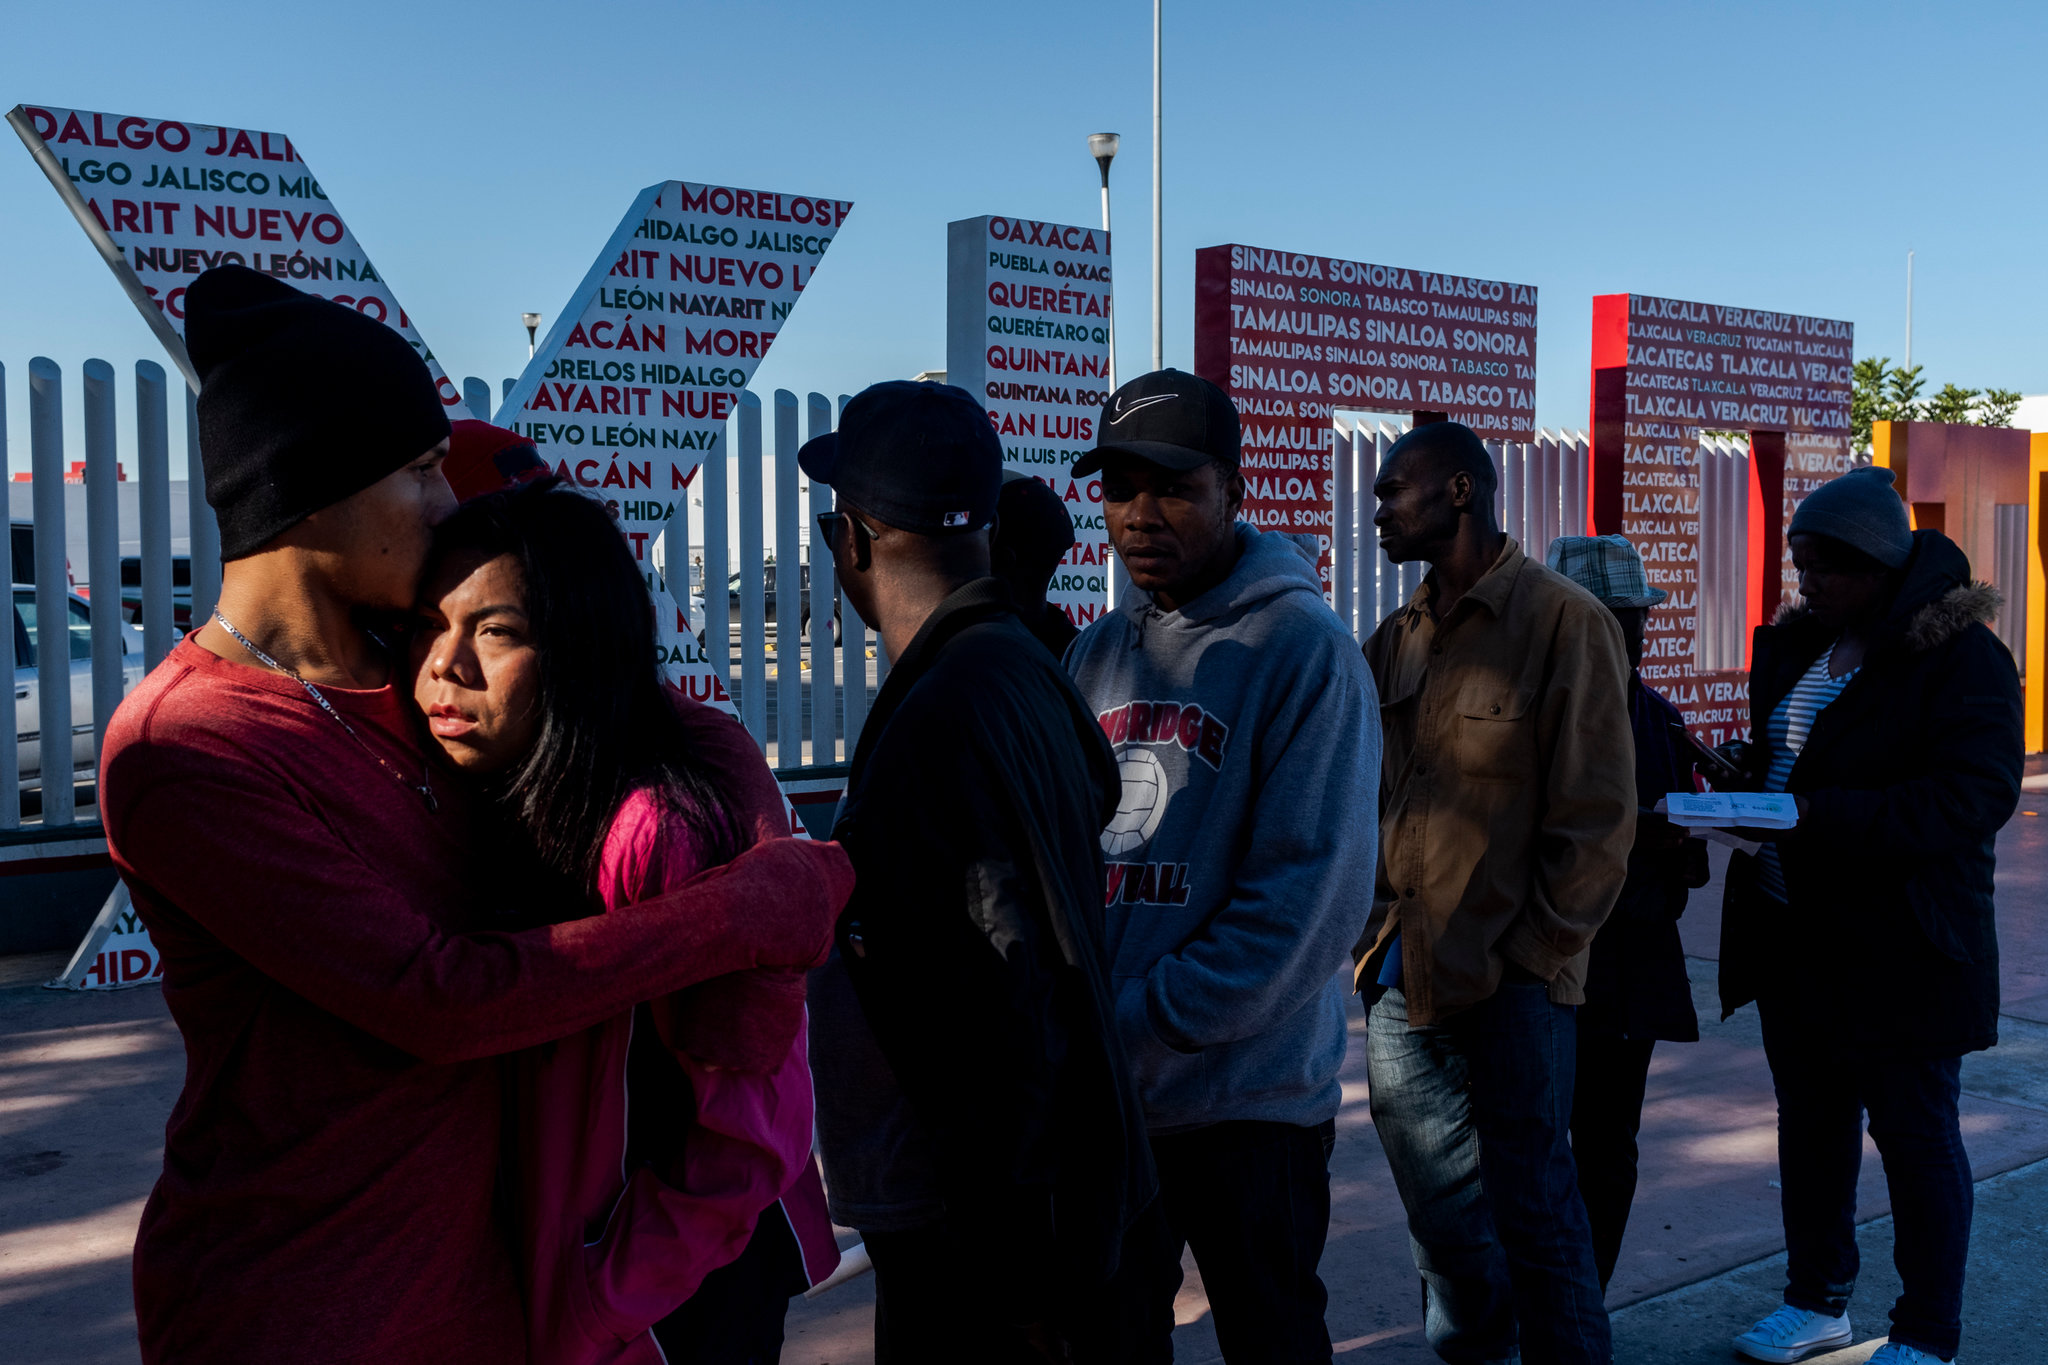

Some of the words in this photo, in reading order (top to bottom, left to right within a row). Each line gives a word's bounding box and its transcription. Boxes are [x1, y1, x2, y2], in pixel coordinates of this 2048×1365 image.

[205, 127, 304, 163] JALI
[142, 164, 270, 195] JALISCO
[194, 204, 344, 245] NUEVO
[634, 218, 738, 247] HIDALGO
[745, 230, 831, 255] JALISCO
[989, 216, 1098, 254] OAXACA
[253, 249, 332, 281] LEÓN
[337, 259, 384, 283] NA
[670, 253, 783, 289] NUEVO
[989, 252, 1049, 274] PUEBLA
[1053, 260, 1111, 283] OAXAC
[1231, 246, 1323, 280] SINALOA
[1328, 259, 1414, 292] SONORA
[1419, 272, 1504, 302] TABASCO
[600, 285, 664, 311] LEÓN
[669, 292, 766, 320] NAYARIT
[1230, 278, 1296, 302] SINALOA
[1300, 287, 1362, 309] SONORA
[1365, 294, 1429, 316] TABASCO
[1431, 302, 1510, 326] TAMAULIPAS
[1629, 294, 1710, 324] TLAXCALA
[1715, 306, 1791, 333] VERACRUZ
[565, 314, 666, 352] ACÁN
[988, 315, 1088, 342] QUERÉTARO
[1230, 304, 1361, 340] TAMAULIPAS
[1365, 319, 1448, 349] SINALOA
[1453, 328, 1529, 357] SONORA
[1628, 322, 1683, 342] TLAXCALA
[1686, 329, 1741, 348] VERACRUZ
[1745, 335, 1792, 353] YUCATAN
[1794, 341, 1845, 359] TLAXCALA
[986, 345, 1110, 378] QUINTANA
[1230, 336, 1322, 361] TAMAULIPAS
[1325, 346, 1387, 367] SINALOA
[1390, 352, 1447, 373] SONORA
[1450, 358, 1509, 377] TABASCO
[1627, 344, 1714, 372] ZACATECAS
[1721, 354, 1797, 380] TLAXCALA
[642, 363, 746, 388] HIDALGO
[986, 381, 1072, 404] QUINTANA
[1230, 364, 1323, 394] SINALOA
[1328, 372, 1413, 401] SONORA
[1418, 380, 1503, 407] TABASCO
[1625, 372, 1689, 391] ZACATECAS
[1692, 377, 1746, 395] TLAXCALA
[1750, 382, 1803, 400] VERACRUZ
[1807, 388, 1852, 404] ZACATEC
[523, 382, 653, 416] AYARIT
[1625, 393, 1706, 419] TLAXCALA
[1711, 400, 1788, 425] VERACRUZ
[510, 422, 585, 445] UEVO
[592, 422, 656, 448] LEÓN
[1043, 415, 1093, 441] LUIS
[1240, 424, 1333, 451] AMAULIP
[1624, 422, 1680, 439] TLAXCALA
[1791, 432, 1842, 448] TLAXCALA
[1023, 447, 1056, 464] LUIS
[1624, 443, 1700, 466] ZACATECA
[1623, 471, 1686, 488] ZACATECAS
[1104, 861, 1192, 908] YBALL
